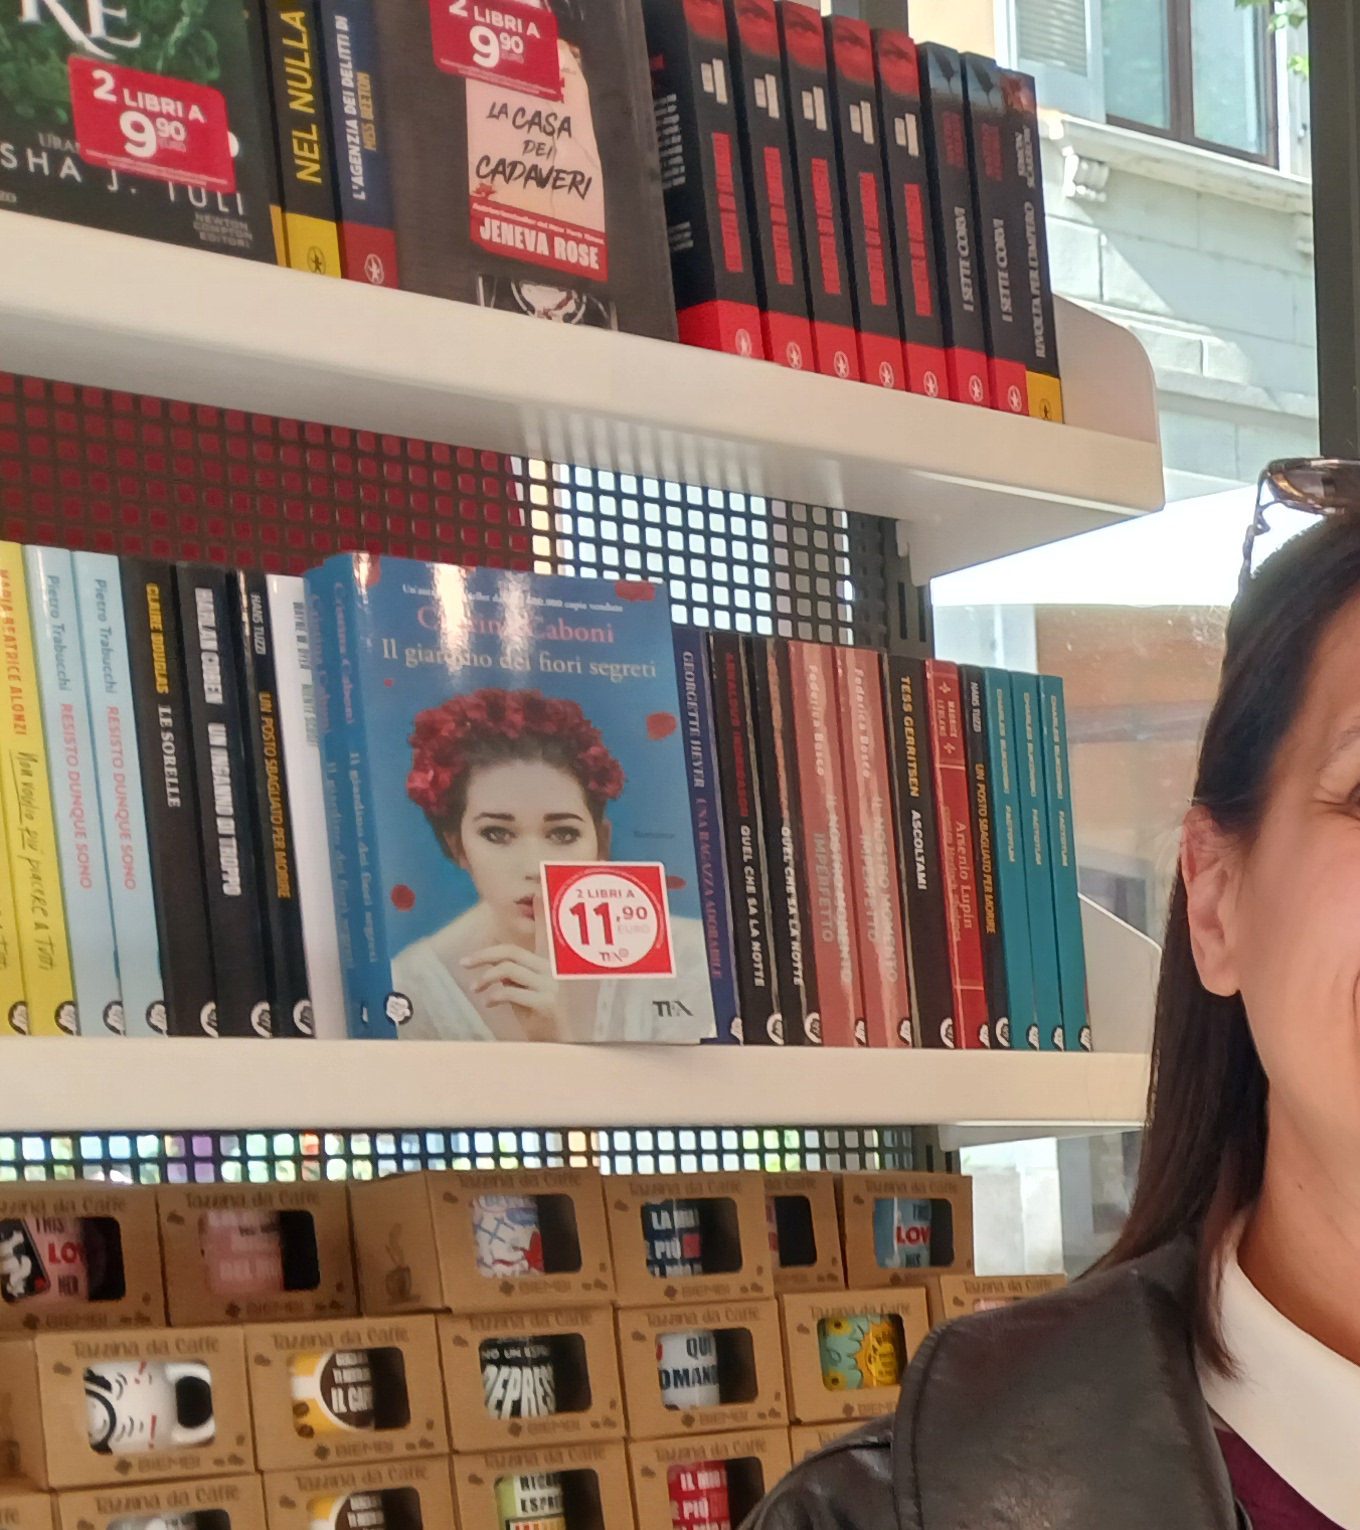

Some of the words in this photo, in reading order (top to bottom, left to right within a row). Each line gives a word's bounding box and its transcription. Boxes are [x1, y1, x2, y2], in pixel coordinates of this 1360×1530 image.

[335, 15, 348, 31] DI
[474, 6, 523, 33] LIBRI
[527, 22, 541, 38] A
[280, 10, 315, 114] NULLA
[337, 36, 354, 86] DELITTI
[92, 69, 117, 102] 2
[123, 88, 183, 118] LIBRI
[189, 104, 206, 124] A
[341, 93, 357, 116] DEI
[486, 102, 508, 119] LA
[512, 107, 572, 139] CASA
[292, 123, 322, 184] NEL
[346, 119, 366, 200] L'AGENZIA
[522, 139, 558, 159] DEI
[476, 155, 592, 200] CADAVERI
[479, 216, 550, 256] JENEVA
[554, 237, 599, 270] ROSE
[250, 594, 264, 624] HANS
[52, 625, 72, 691] Trabucchi
[99, 627, 116, 695] Trabucchi
[254, 626, 267, 655] TUZZI
[382, 638, 397, 660] Il
[540, 652, 582, 674] fiori
[589, 660, 656, 683] segreti
[901, 676, 913, 710] TESS
[61, 703, 79, 767] RESISTO
[107, 706, 125, 768] RESISTO
[158, 705, 172, 728] LE
[262, 716, 277, 754] POSTO
[160, 730, 181, 808] SORELLE
[903, 715, 919, 797] GERRITSEN
[66, 771, 85, 842] DUNQUE
[112, 771, 132, 844] DUNQUE
[264, 758, 284, 825] SBAGLIATO
[272, 826, 285, 849] PER
[740, 825, 753, 861] QUEL
[911, 809, 927, 890] ASCOLTAMI
[76, 845, 93, 890] SONO
[122, 846, 137, 890] SONO
[744, 863, 755, 893] CHE
[955, 821, 968, 880] Arsenio
[962, 884, 975, 928] Lupin
[576, 889, 583, 898] 2
[587, 890, 622, 898] LIBRI
[627, 889, 635, 898] A
[747, 896, 757, 915] SA
[750, 919, 760, 938] LA
[752, 942, 765, 987] NOTTE
